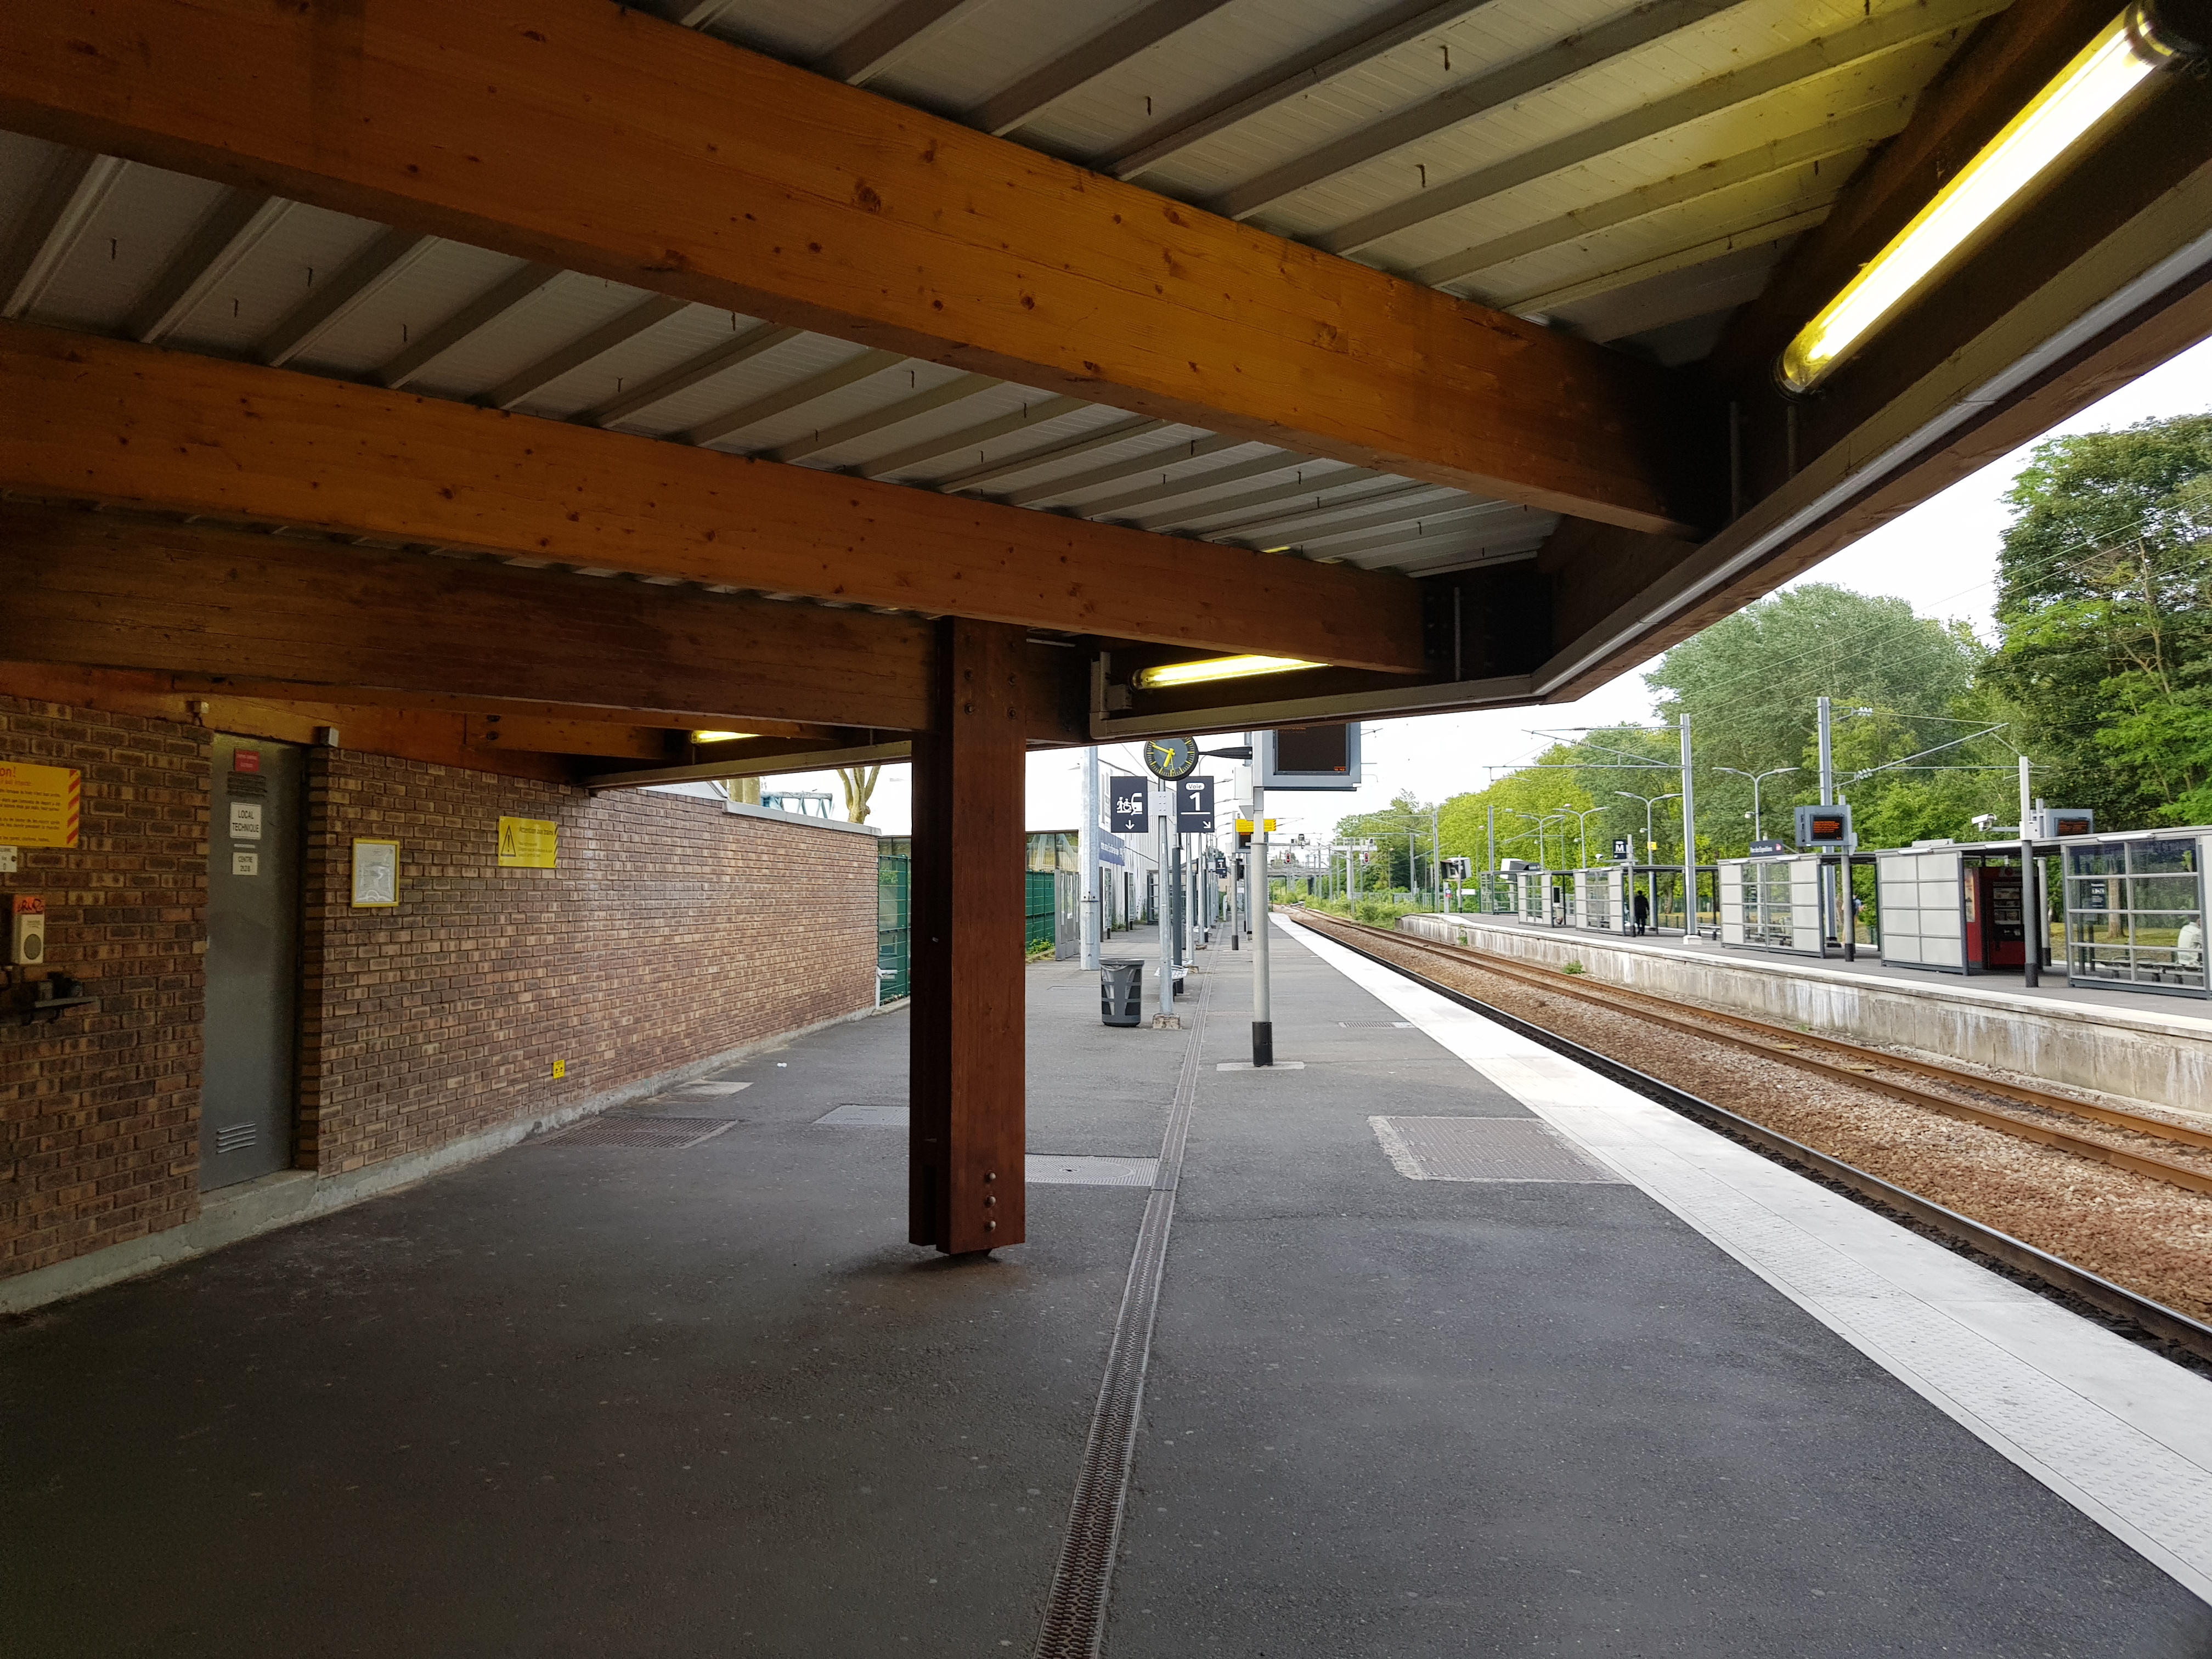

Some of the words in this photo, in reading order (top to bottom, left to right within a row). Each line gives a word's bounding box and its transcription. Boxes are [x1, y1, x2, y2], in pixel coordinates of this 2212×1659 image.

[1189, 792, 1200, 811] 1
[238, 809, 254, 819] LOCAL
[232, 822, 259, 833] TECHNIQUE
